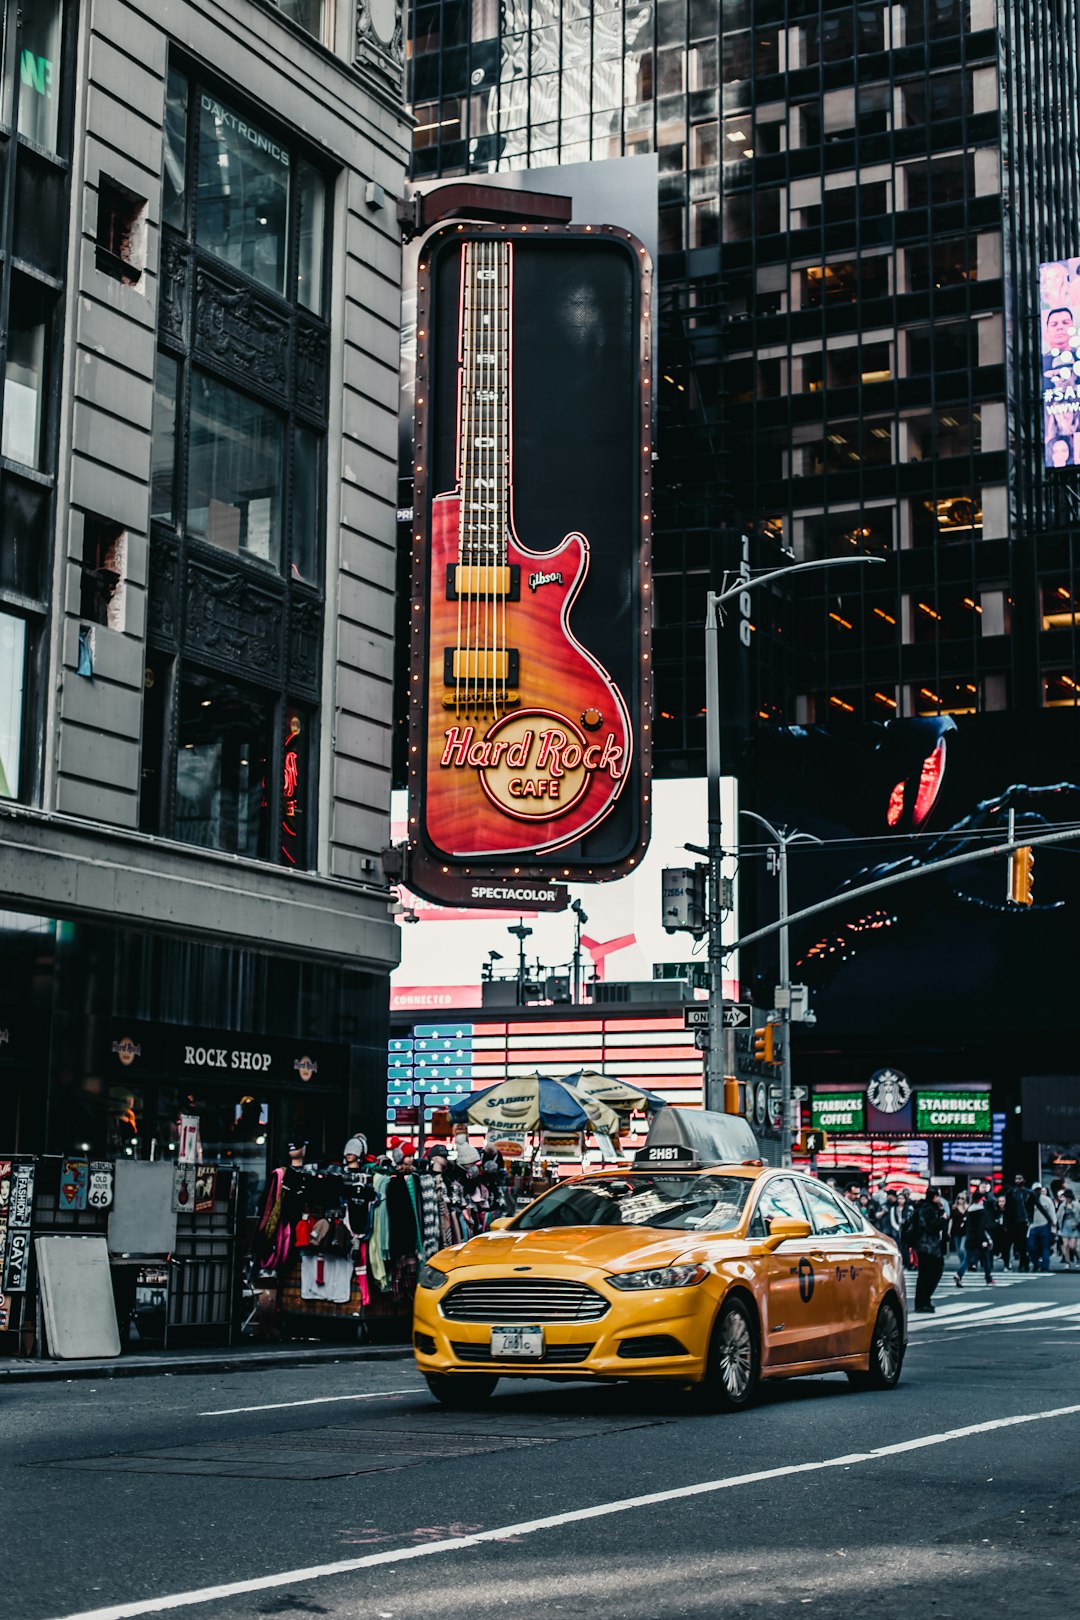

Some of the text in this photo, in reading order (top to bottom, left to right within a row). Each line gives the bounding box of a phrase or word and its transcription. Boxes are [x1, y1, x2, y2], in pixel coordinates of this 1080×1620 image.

[201, 94, 289, 167] DAKTRONICS
[529, 571, 564, 590] Gibson
[740, 534, 751, 648] 1500
[440, 726, 623, 779] Hard Rock
[508, 778, 560, 797] CAFE
[471, 887, 556, 901] SPECTACOLOR
[674, 964, 681, 978] 7
[394, 994, 452, 1005] CONNECTED
[184, 1046, 272, 1071] ROCK SHOP
[812, 1098, 863, 1113] STARBUCKS
[919, 1098, 989, 1111] STARBUCKS
[820, 1112, 853, 1125] COFFEE
[930, 1112, 976, 1125] COFFEE
[95, 1175, 107, 1183] OLD
[16, 1178, 28, 1217] FASHION
[92, 1191, 108, 1205] 66
[10, 1236, 25, 1285] GAY ST
